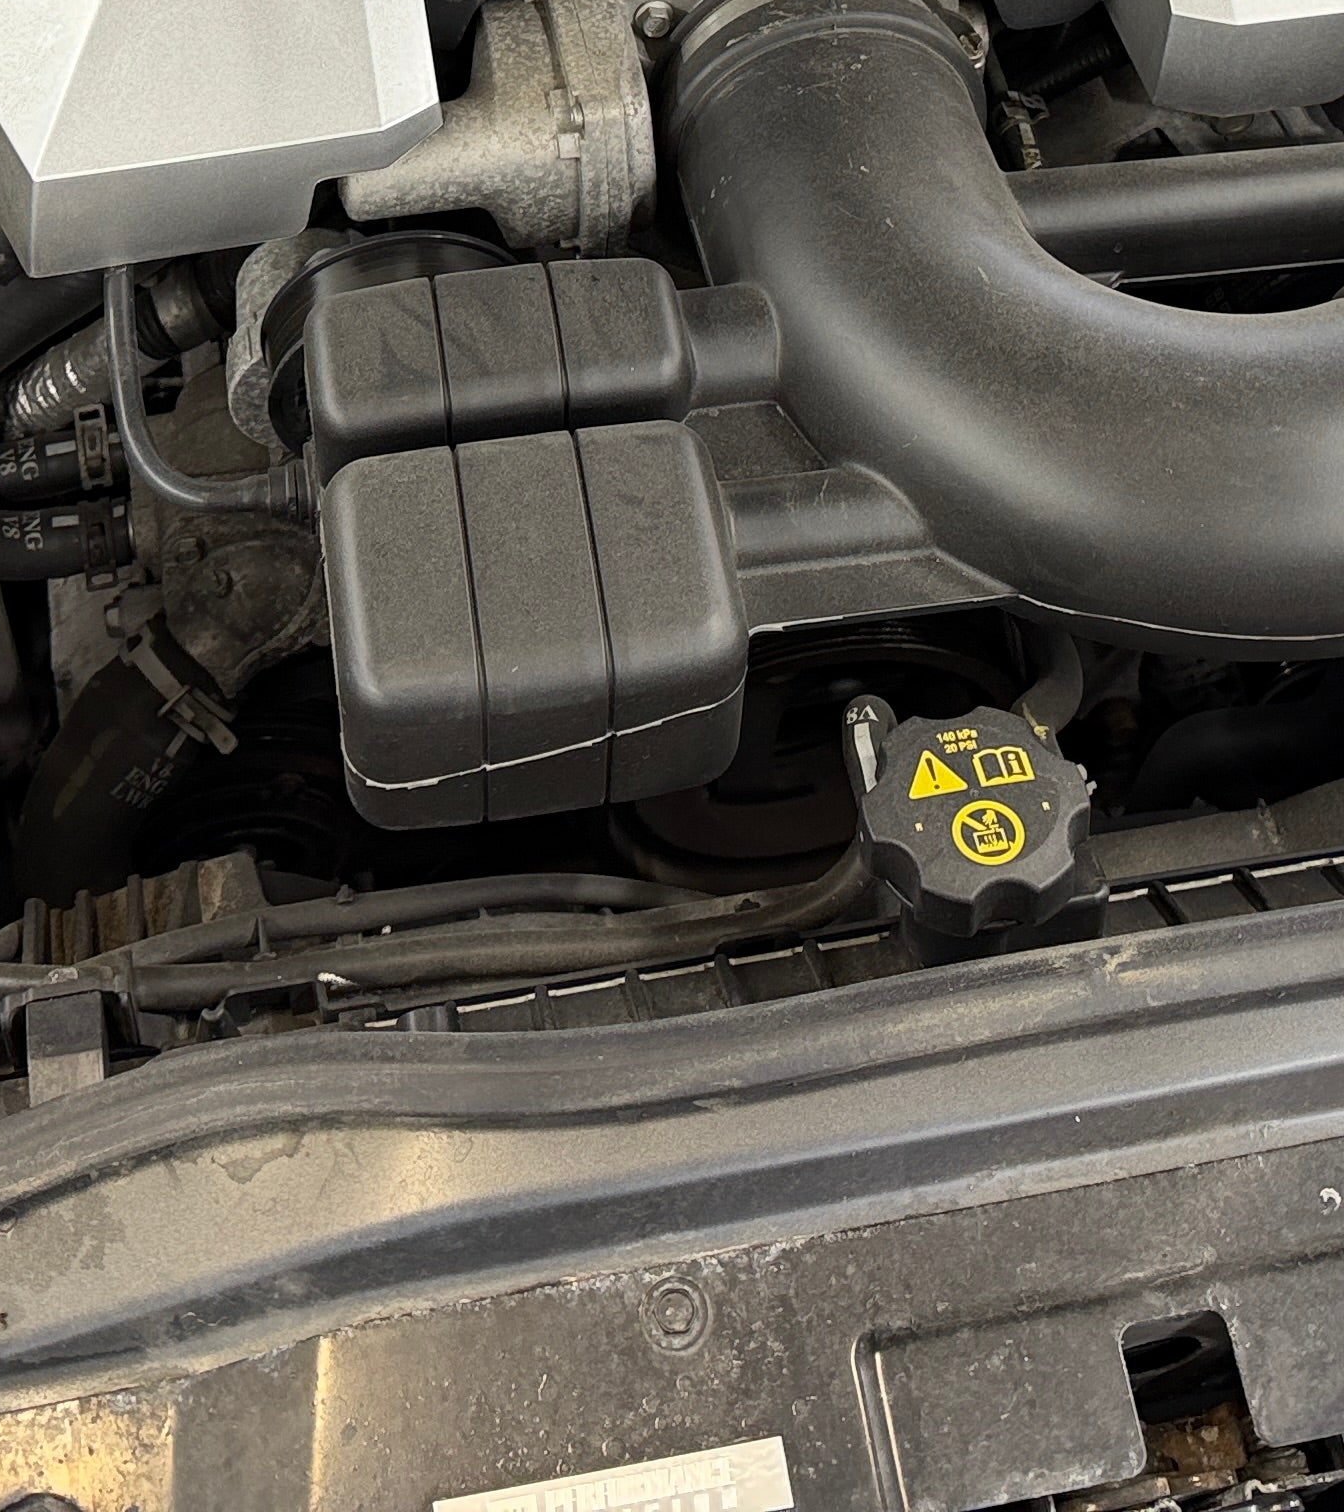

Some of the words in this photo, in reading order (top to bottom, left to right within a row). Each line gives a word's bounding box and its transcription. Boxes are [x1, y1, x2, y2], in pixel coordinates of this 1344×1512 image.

[18, 437, 39, 481] ENG
[0, 516, 20, 539] V8
[22, 511, 43, 551] ENG
[846, 704, 879, 724] V8
[936, 731, 956, 744] 140
[956, 728, 978, 740] kPa
[944, 742, 958, 754] 20
[958, 740, 977, 752] PSI
